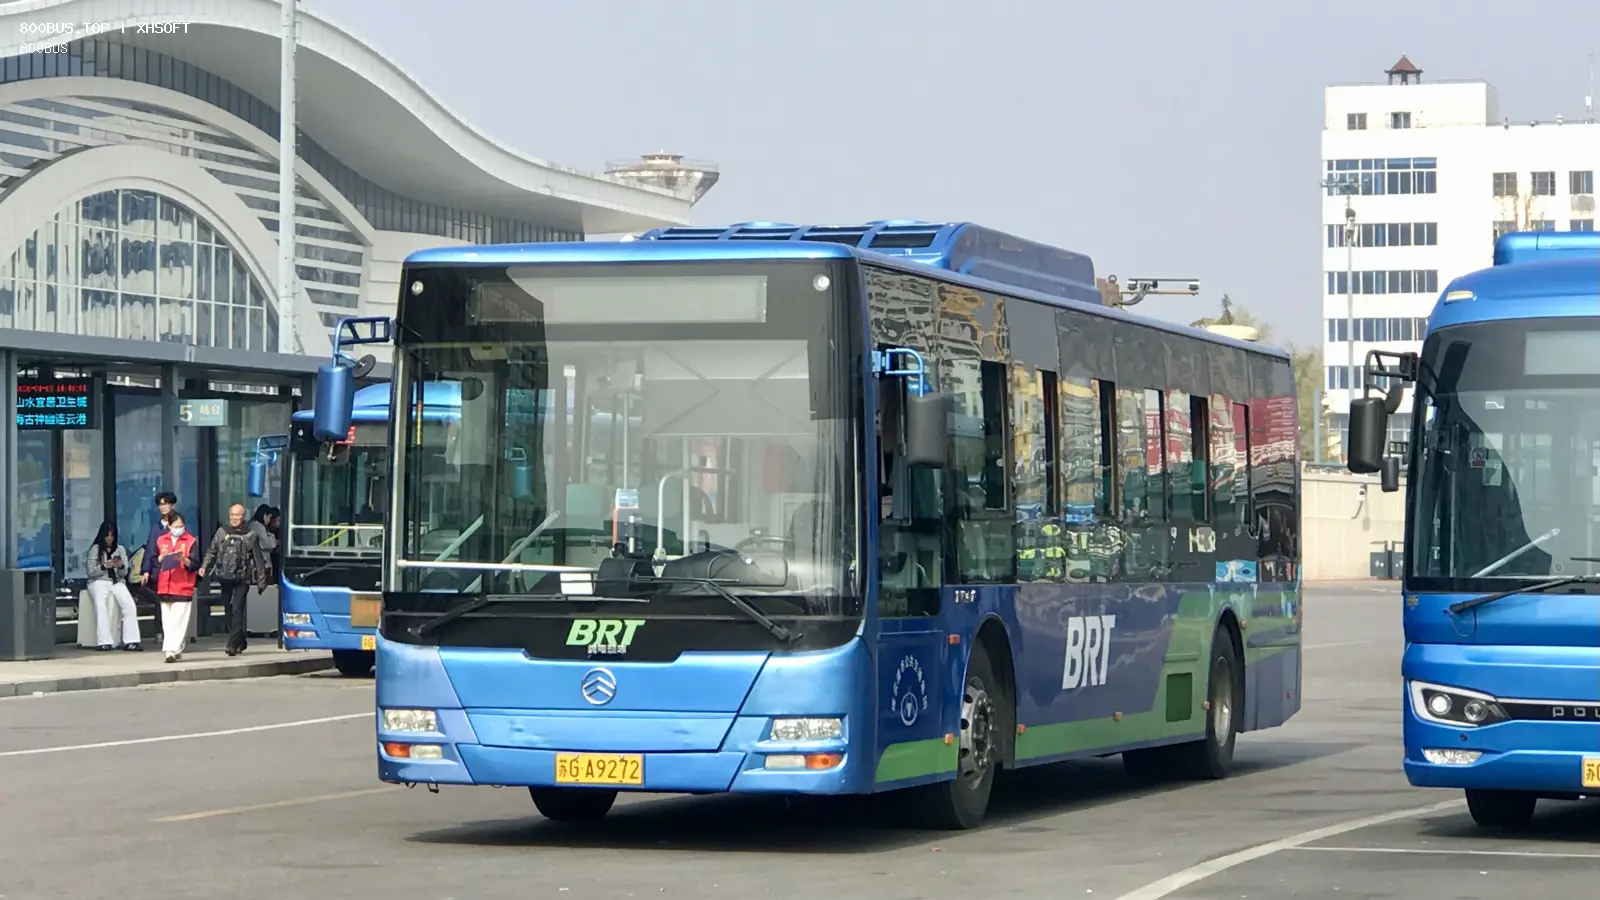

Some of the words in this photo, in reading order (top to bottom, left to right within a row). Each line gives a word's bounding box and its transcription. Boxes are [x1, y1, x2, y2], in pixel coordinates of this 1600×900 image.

[179, 404, 193, 422] 5
[565, 619, 646, 646] BRT
[1061, 614, 1117, 690] BRT
